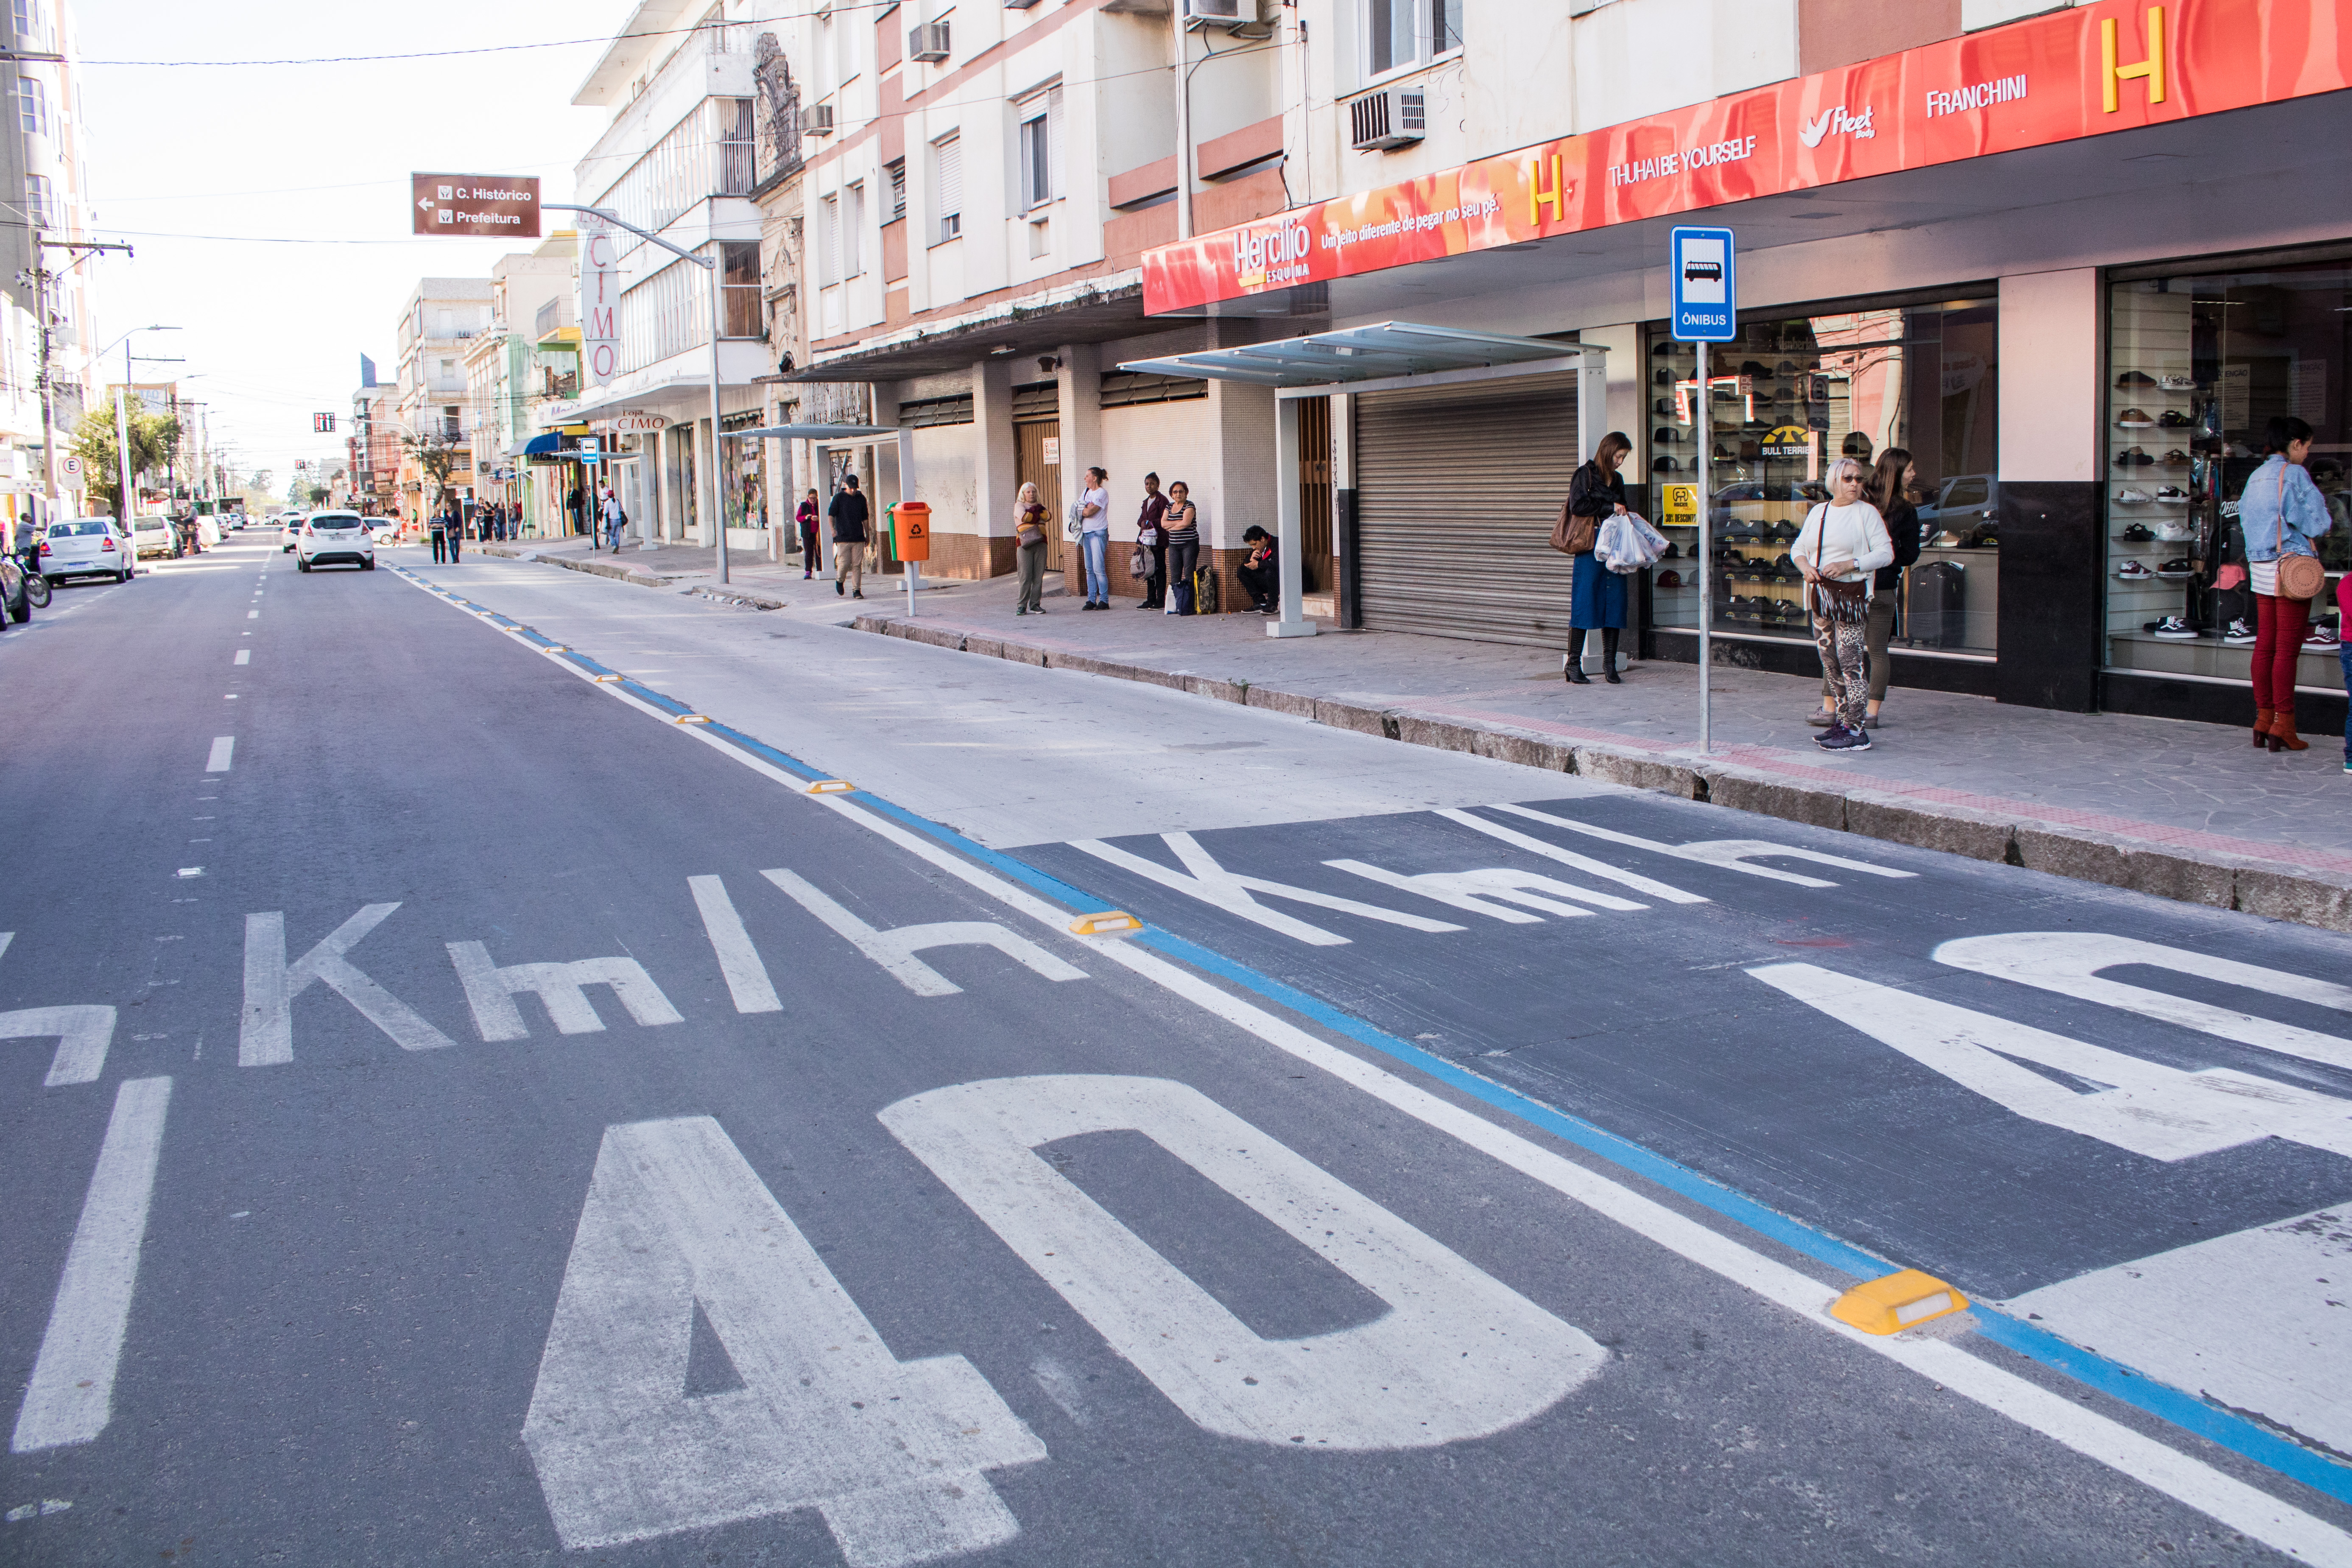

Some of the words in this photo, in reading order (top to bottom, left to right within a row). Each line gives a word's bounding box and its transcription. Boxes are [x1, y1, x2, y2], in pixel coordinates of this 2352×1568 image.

[2101, 6, 2165, 113] H
[1927, 74, 2027, 118] FRANCHINI
[1832, 105, 1874, 135] Fleet
[1855, 128, 1877, 139] Body
[1609, 158, 1660, 187] THUHAI
[1661, 153, 1679, 176] BE
[1680, 135, 1757, 171] YOURSELF
[456, 187, 469, 199] C.
[472, 187, 532, 201] Histórico
[1529, 154, 1564, 226] H
[457, 211, 521, 224] Prefeitura
[1321, 234, 1337, 249] Um
[1337, 226, 1358, 249] jeito
[1359, 220, 1402, 241] diferente
[1402, 215, 1416, 232] de
[1416, 210, 1444, 233] pegar
[1446, 207, 1460, 222] no
[1461, 203, 1481, 220] seu
[1482, 193, 1501, 219] pé.
[1234, 218, 1310, 273] Hercílio
[1266, 263, 1310, 283] ESQUINA
[590, 235, 614, 377] CIMO
[1682, 312, 1726, 325] ÔNIBUS
[618, 418, 665, 429] CIMO
[1762, 446, 1781, 456] BULL
[1783, 445, 1816, 455] TERRIER
[68, 461, 75, 470] E
[1665, 514, 1674, 523] 30%
[1675, 514, 1696, 523] DESCONTO
